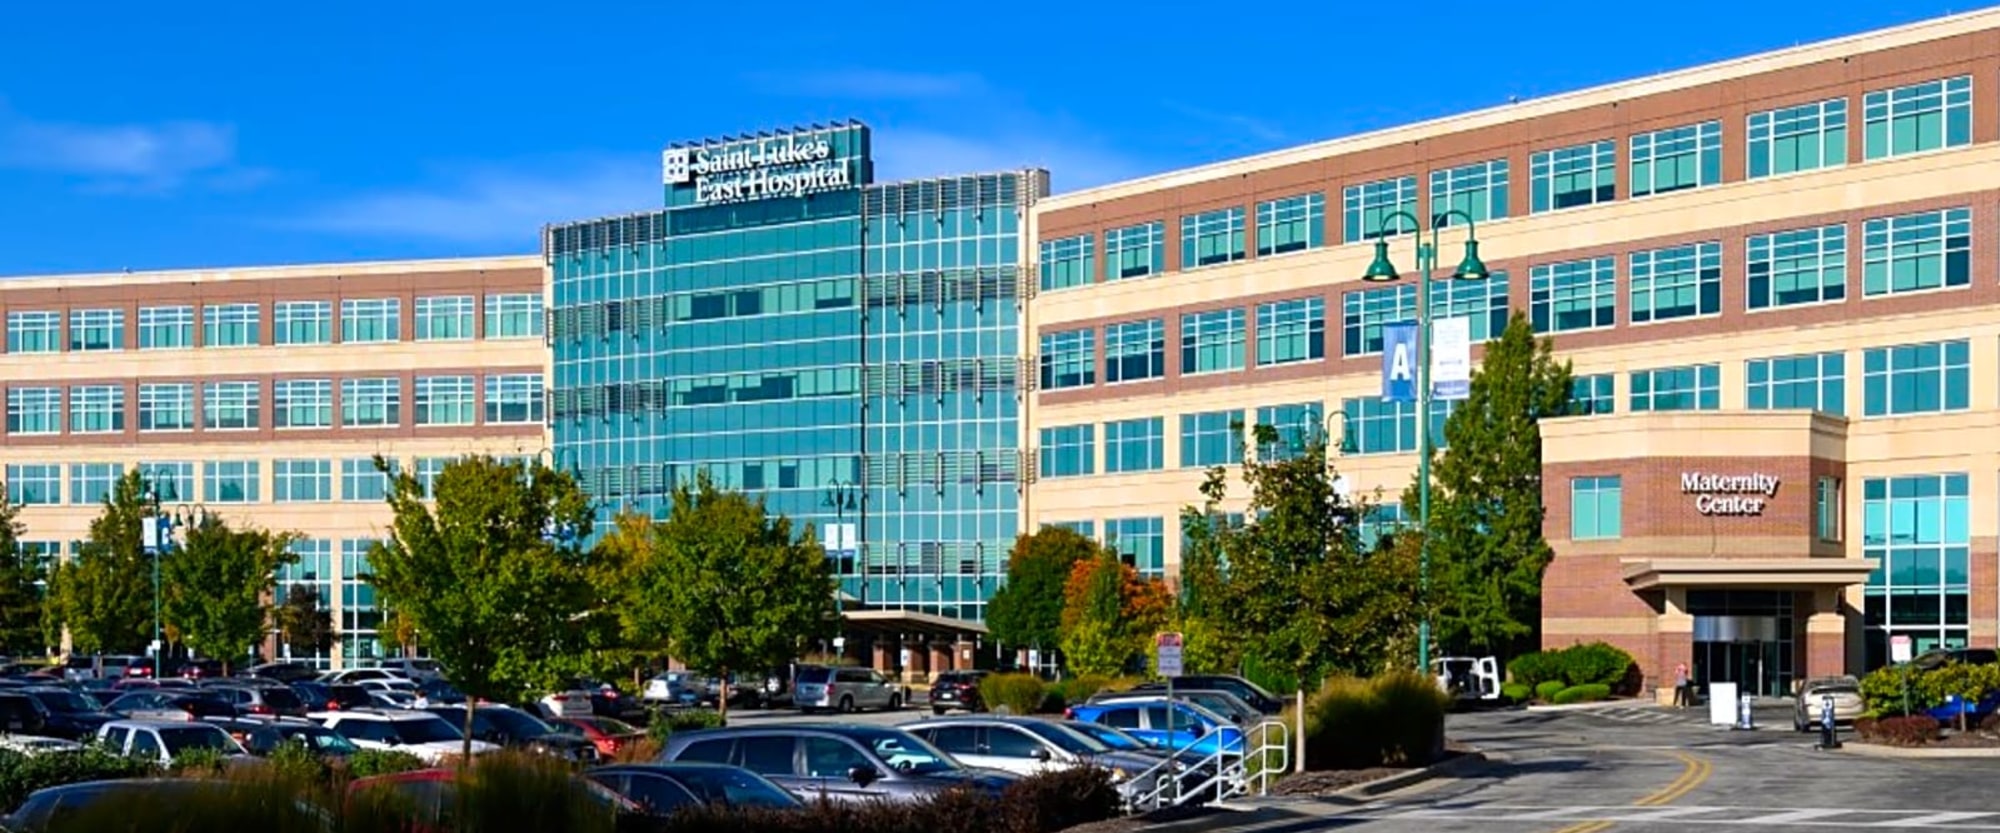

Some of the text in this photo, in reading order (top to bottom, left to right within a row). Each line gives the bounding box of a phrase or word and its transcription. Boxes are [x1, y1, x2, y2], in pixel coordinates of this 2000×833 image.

[696, 134, 830, 175] Saint Luke's
[695, 158, 850, 202] East Hospital
[1390, 343, 1411, 381] A
[1681, 472, 1778, 495] Maternity
[1696, 494, 1764, 513] Center
